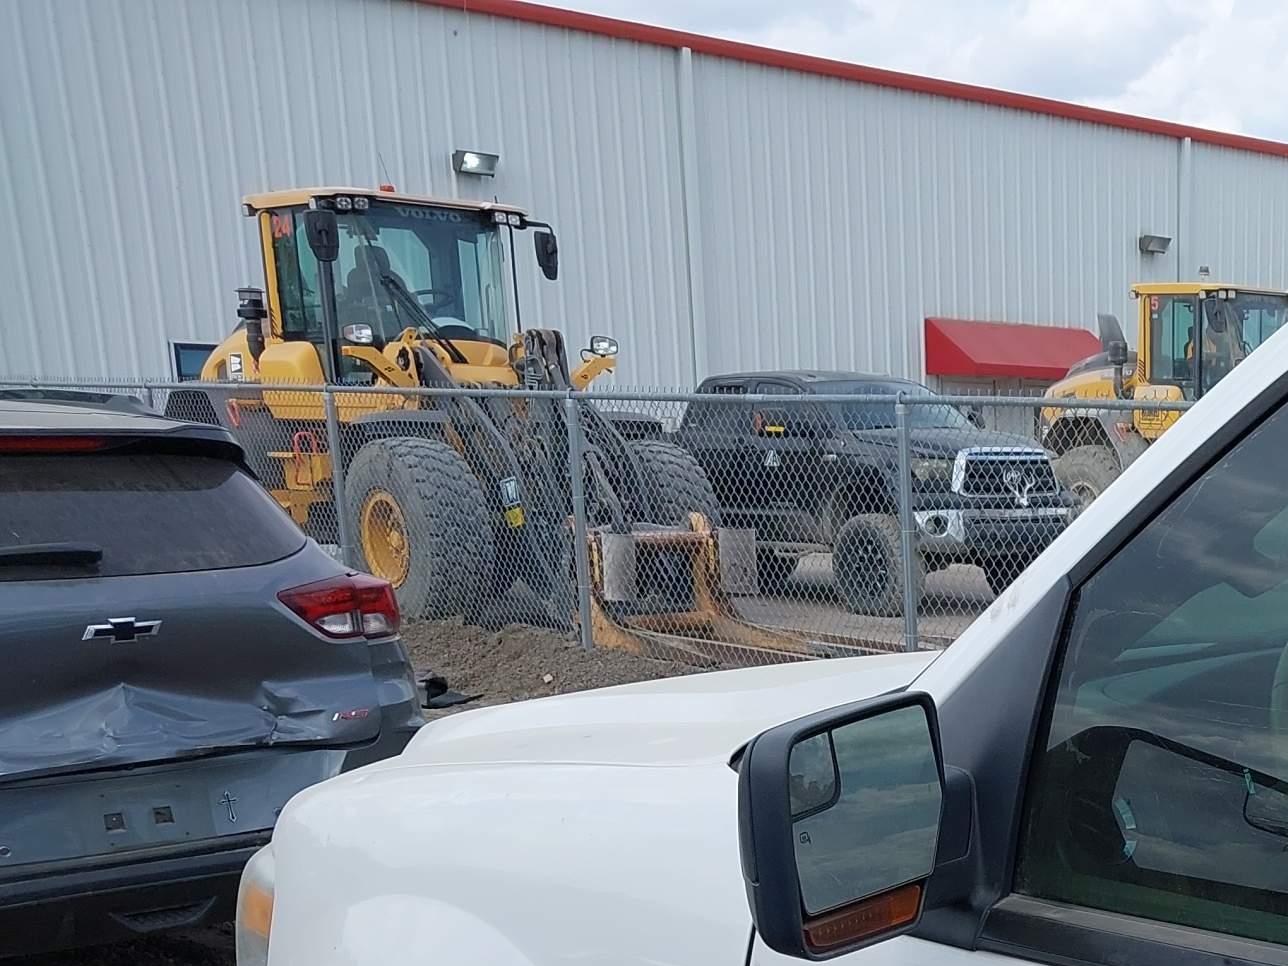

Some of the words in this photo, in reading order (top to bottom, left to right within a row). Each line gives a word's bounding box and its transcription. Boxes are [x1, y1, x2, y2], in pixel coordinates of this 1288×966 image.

[394, 207, 462, 222] VOLVO
[272, 215, 291, 240] 24
[1150, 296, 1159, 311] 5
